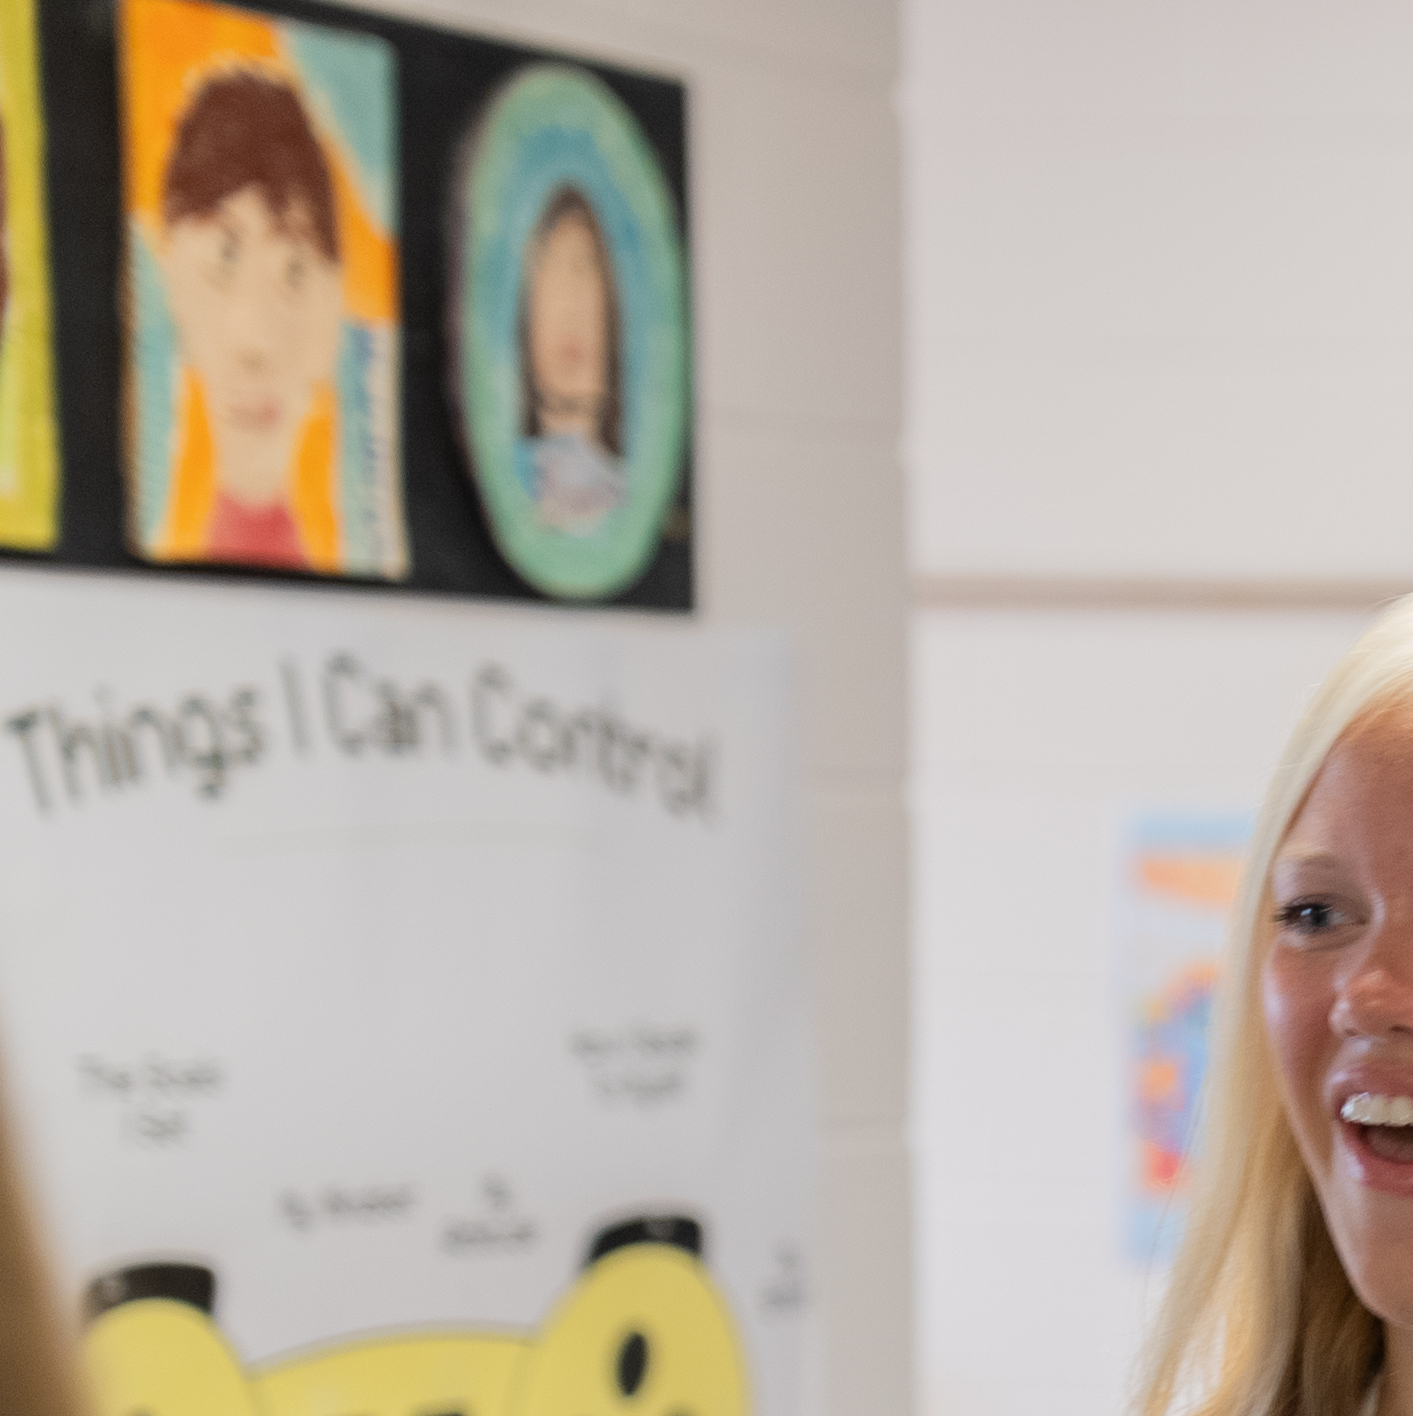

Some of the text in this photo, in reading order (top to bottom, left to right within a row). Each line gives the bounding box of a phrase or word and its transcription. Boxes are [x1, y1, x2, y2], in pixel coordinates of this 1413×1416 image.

[5, 648, 720, 818] Things I Can Control
